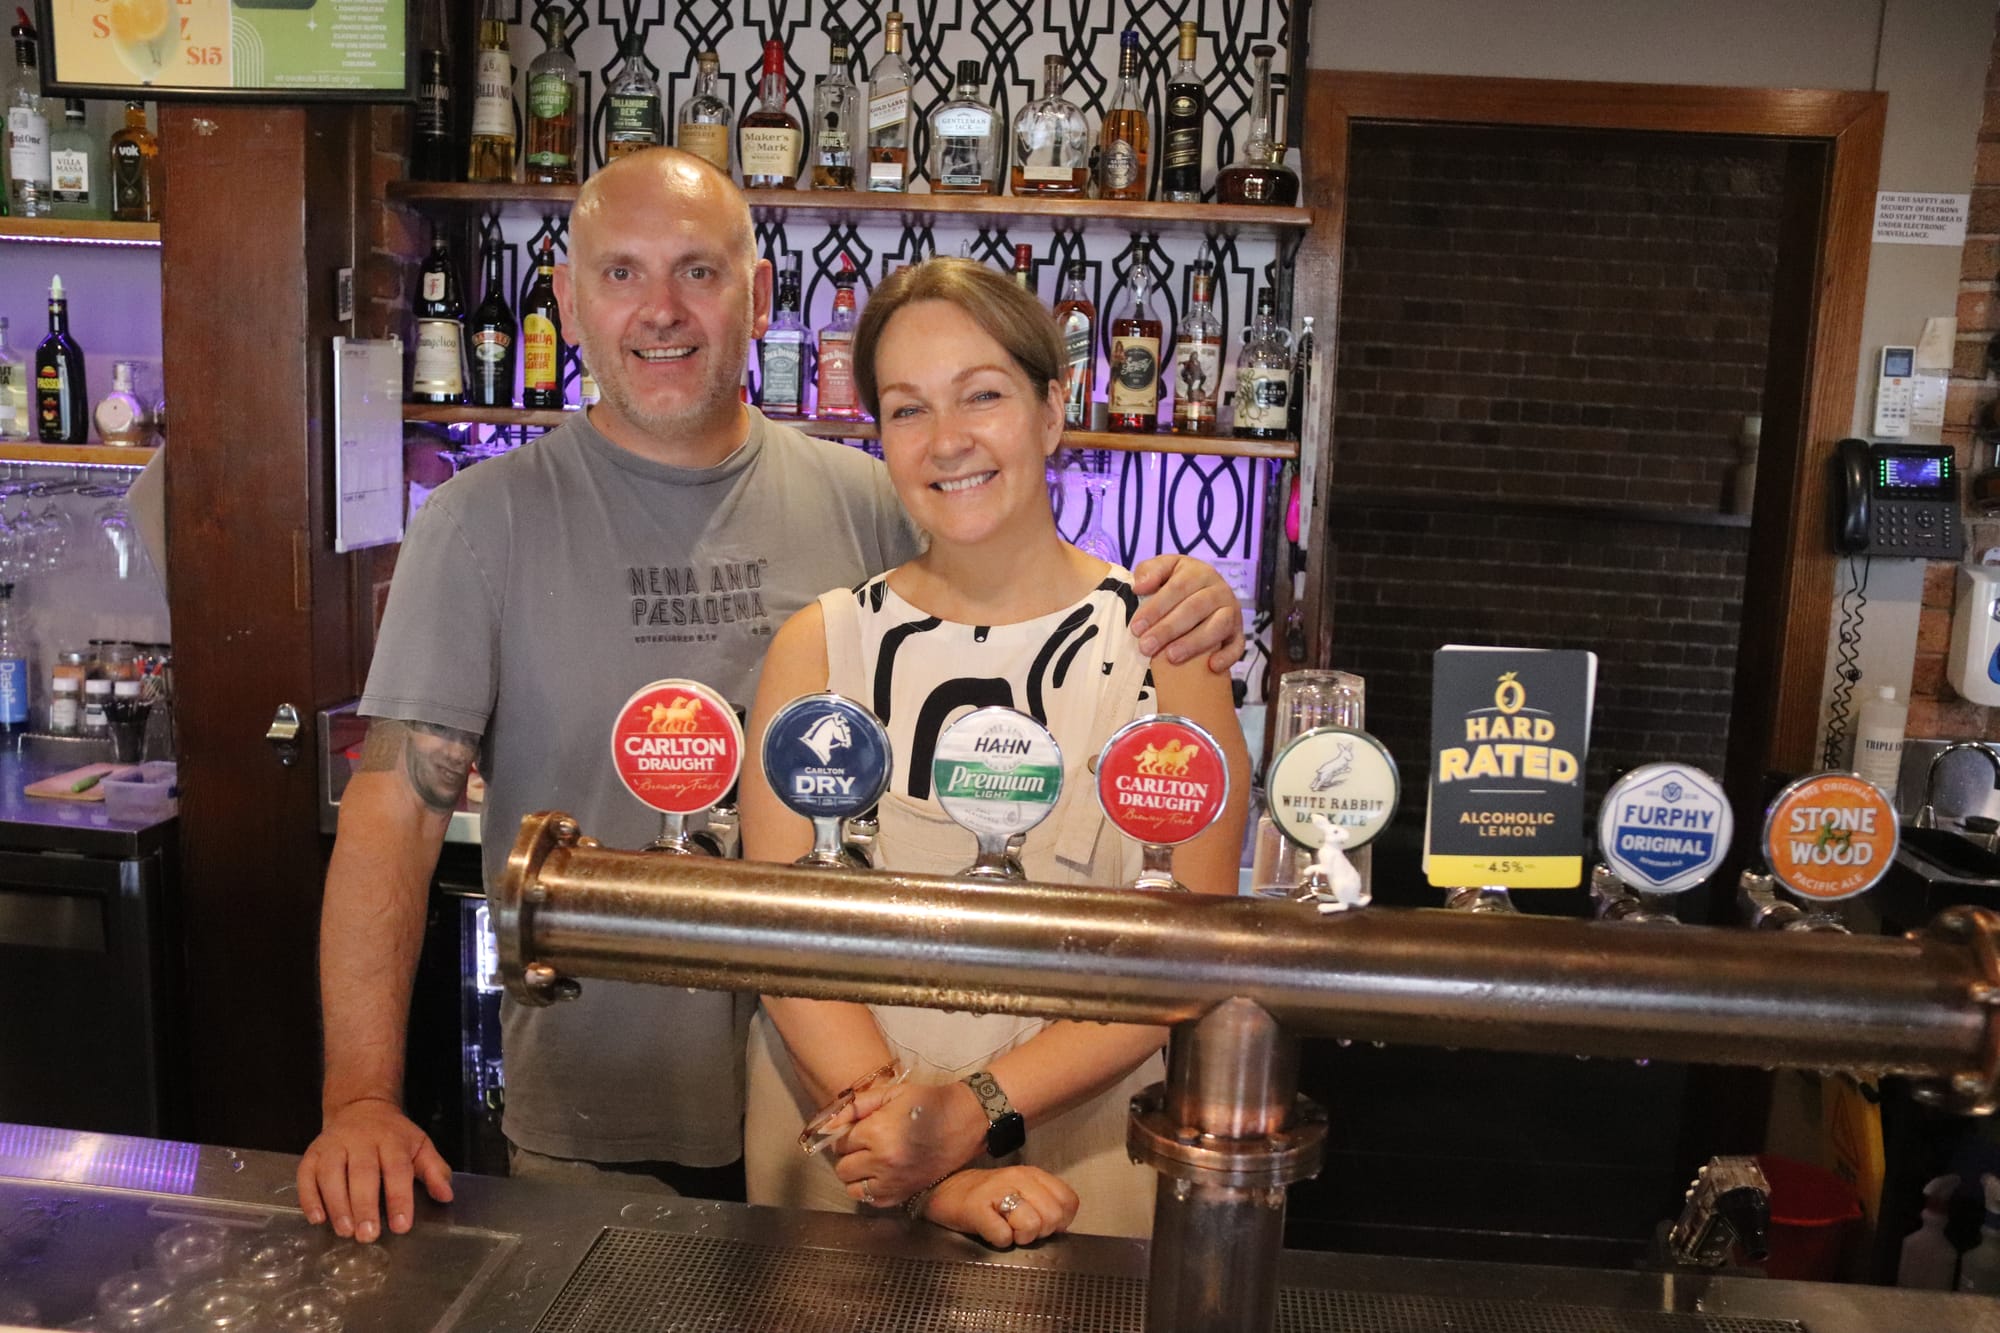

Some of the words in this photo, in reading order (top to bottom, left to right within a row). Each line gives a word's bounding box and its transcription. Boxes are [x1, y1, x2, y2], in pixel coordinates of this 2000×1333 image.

[744, 133, 790, 143] Maker's
[757, 143, 789, 153] Mark
[56, 165, 84, 174] MASSA
[57, 158, 81, 166] VILLA
[1897, 195, 1911, 203] THE
[1880, 204, 1913, 212] SECURITY
[1878, 221, 1902, 229] UNDER
[1903, 222, 1946, 231] ELECTRONIC
[630, 567, 699, 596] NENA
[1465, 716, 1556, 742] HARD
[624, 736, 727, 756] CARLTON
[974, 737, 1032, 755] HAHN
[638, 757, 716, 771] DRAUGHT
[804, 766, 846, 775] CARLTON
[1439, 744, 1579, 784] RATED
[795, 775, 857, 795] DRY
[947, 765, 1046, 793] Premium
[1115, 775, 1209, 799] CARLTON
[974, 790, 1010, 799] LIGHT
[1822, 782, 1873, 802] ORIGINAL
[1119, 792, 1204, 813] DRAUGHT
[1282, 795, 1327, 809] WHITE
[1330, 798, 1384, 811] RABBIT
[1339, 813, 1367, 826] ALE
[1460, 811, 1555, 825] ALCOHOLIC
[1623, 804, 1714, 829] FURPHY
[1790, 807, 1877, 834] STONE
[1479, 825, 1537, 837] LEMON
[1621, 834, 1706, 856] ORIGINAL
[1790, 840, 1874, 865] WOOD
[1488, 860, 1525, 873] 4.5%
[1792, 871, 1838, 892] PACIFIC
[1841, 871, 1864, 889] ALE
